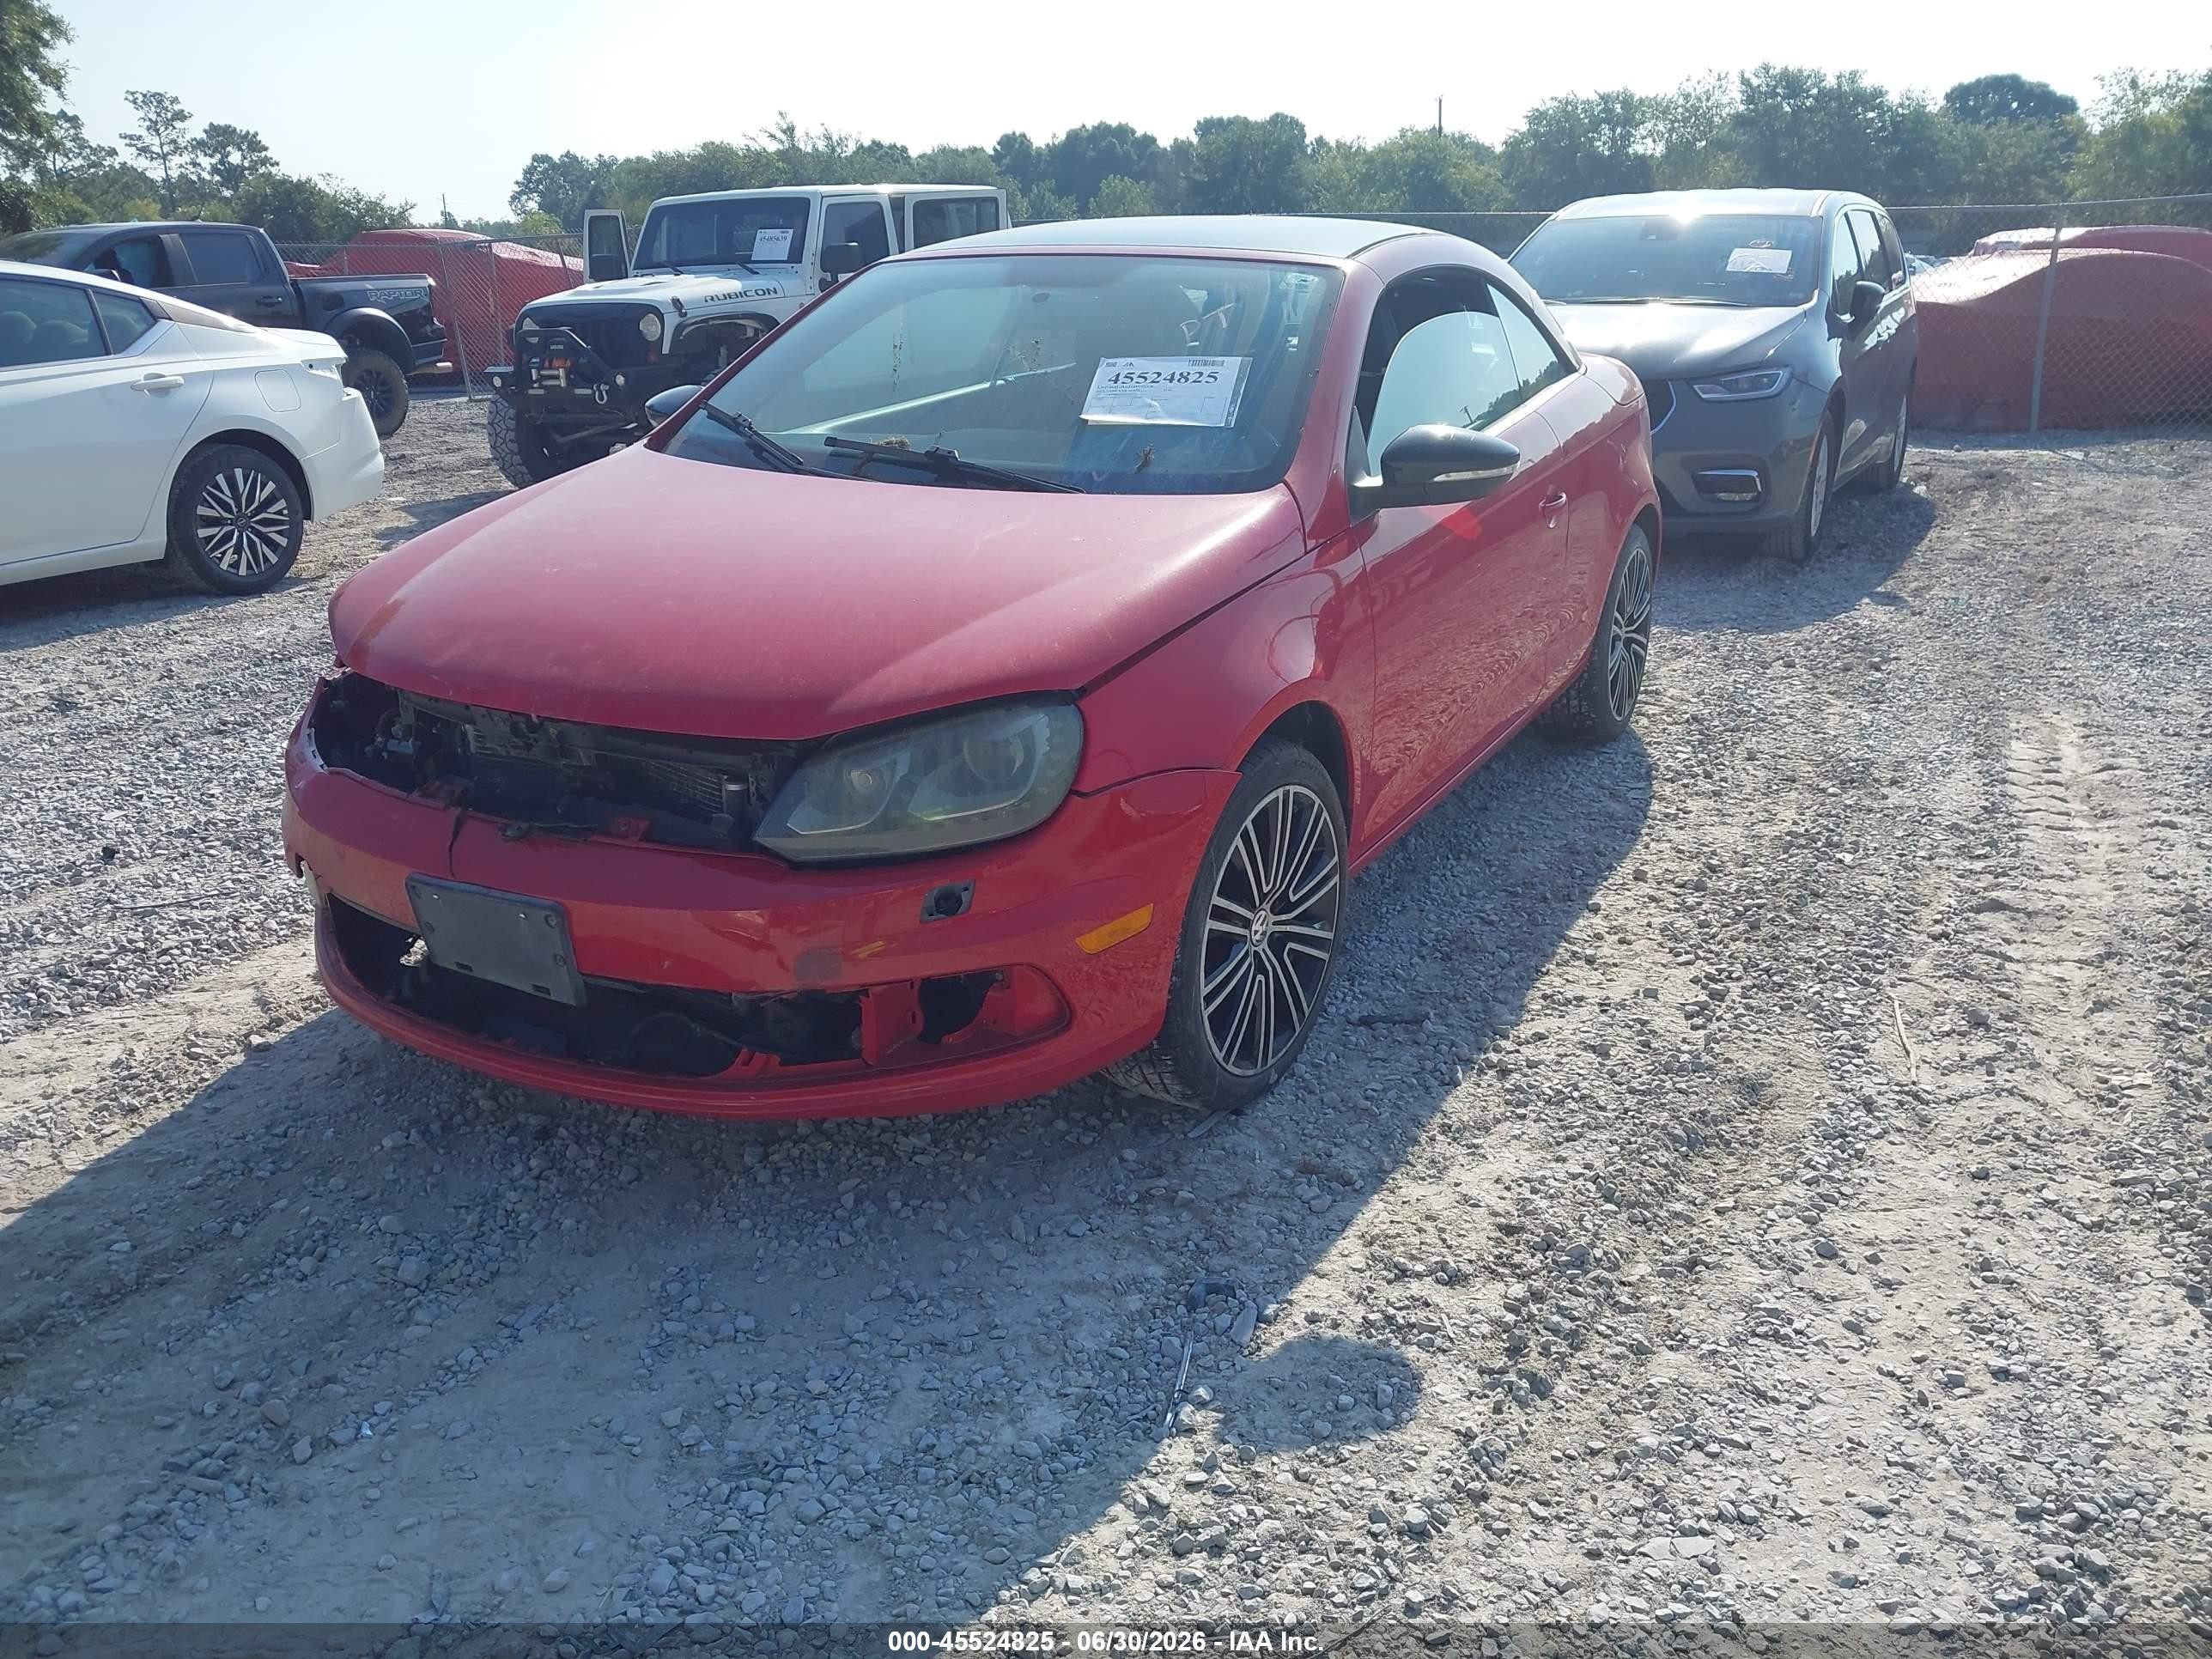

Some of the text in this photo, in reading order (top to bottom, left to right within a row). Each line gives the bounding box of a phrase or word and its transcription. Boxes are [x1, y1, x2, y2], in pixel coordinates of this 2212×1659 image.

[367, 289, 428, 304] RAPTOR
[704, 287, 778, 302] RUBICON
[1108, 371, 1220, 385] 45524825
